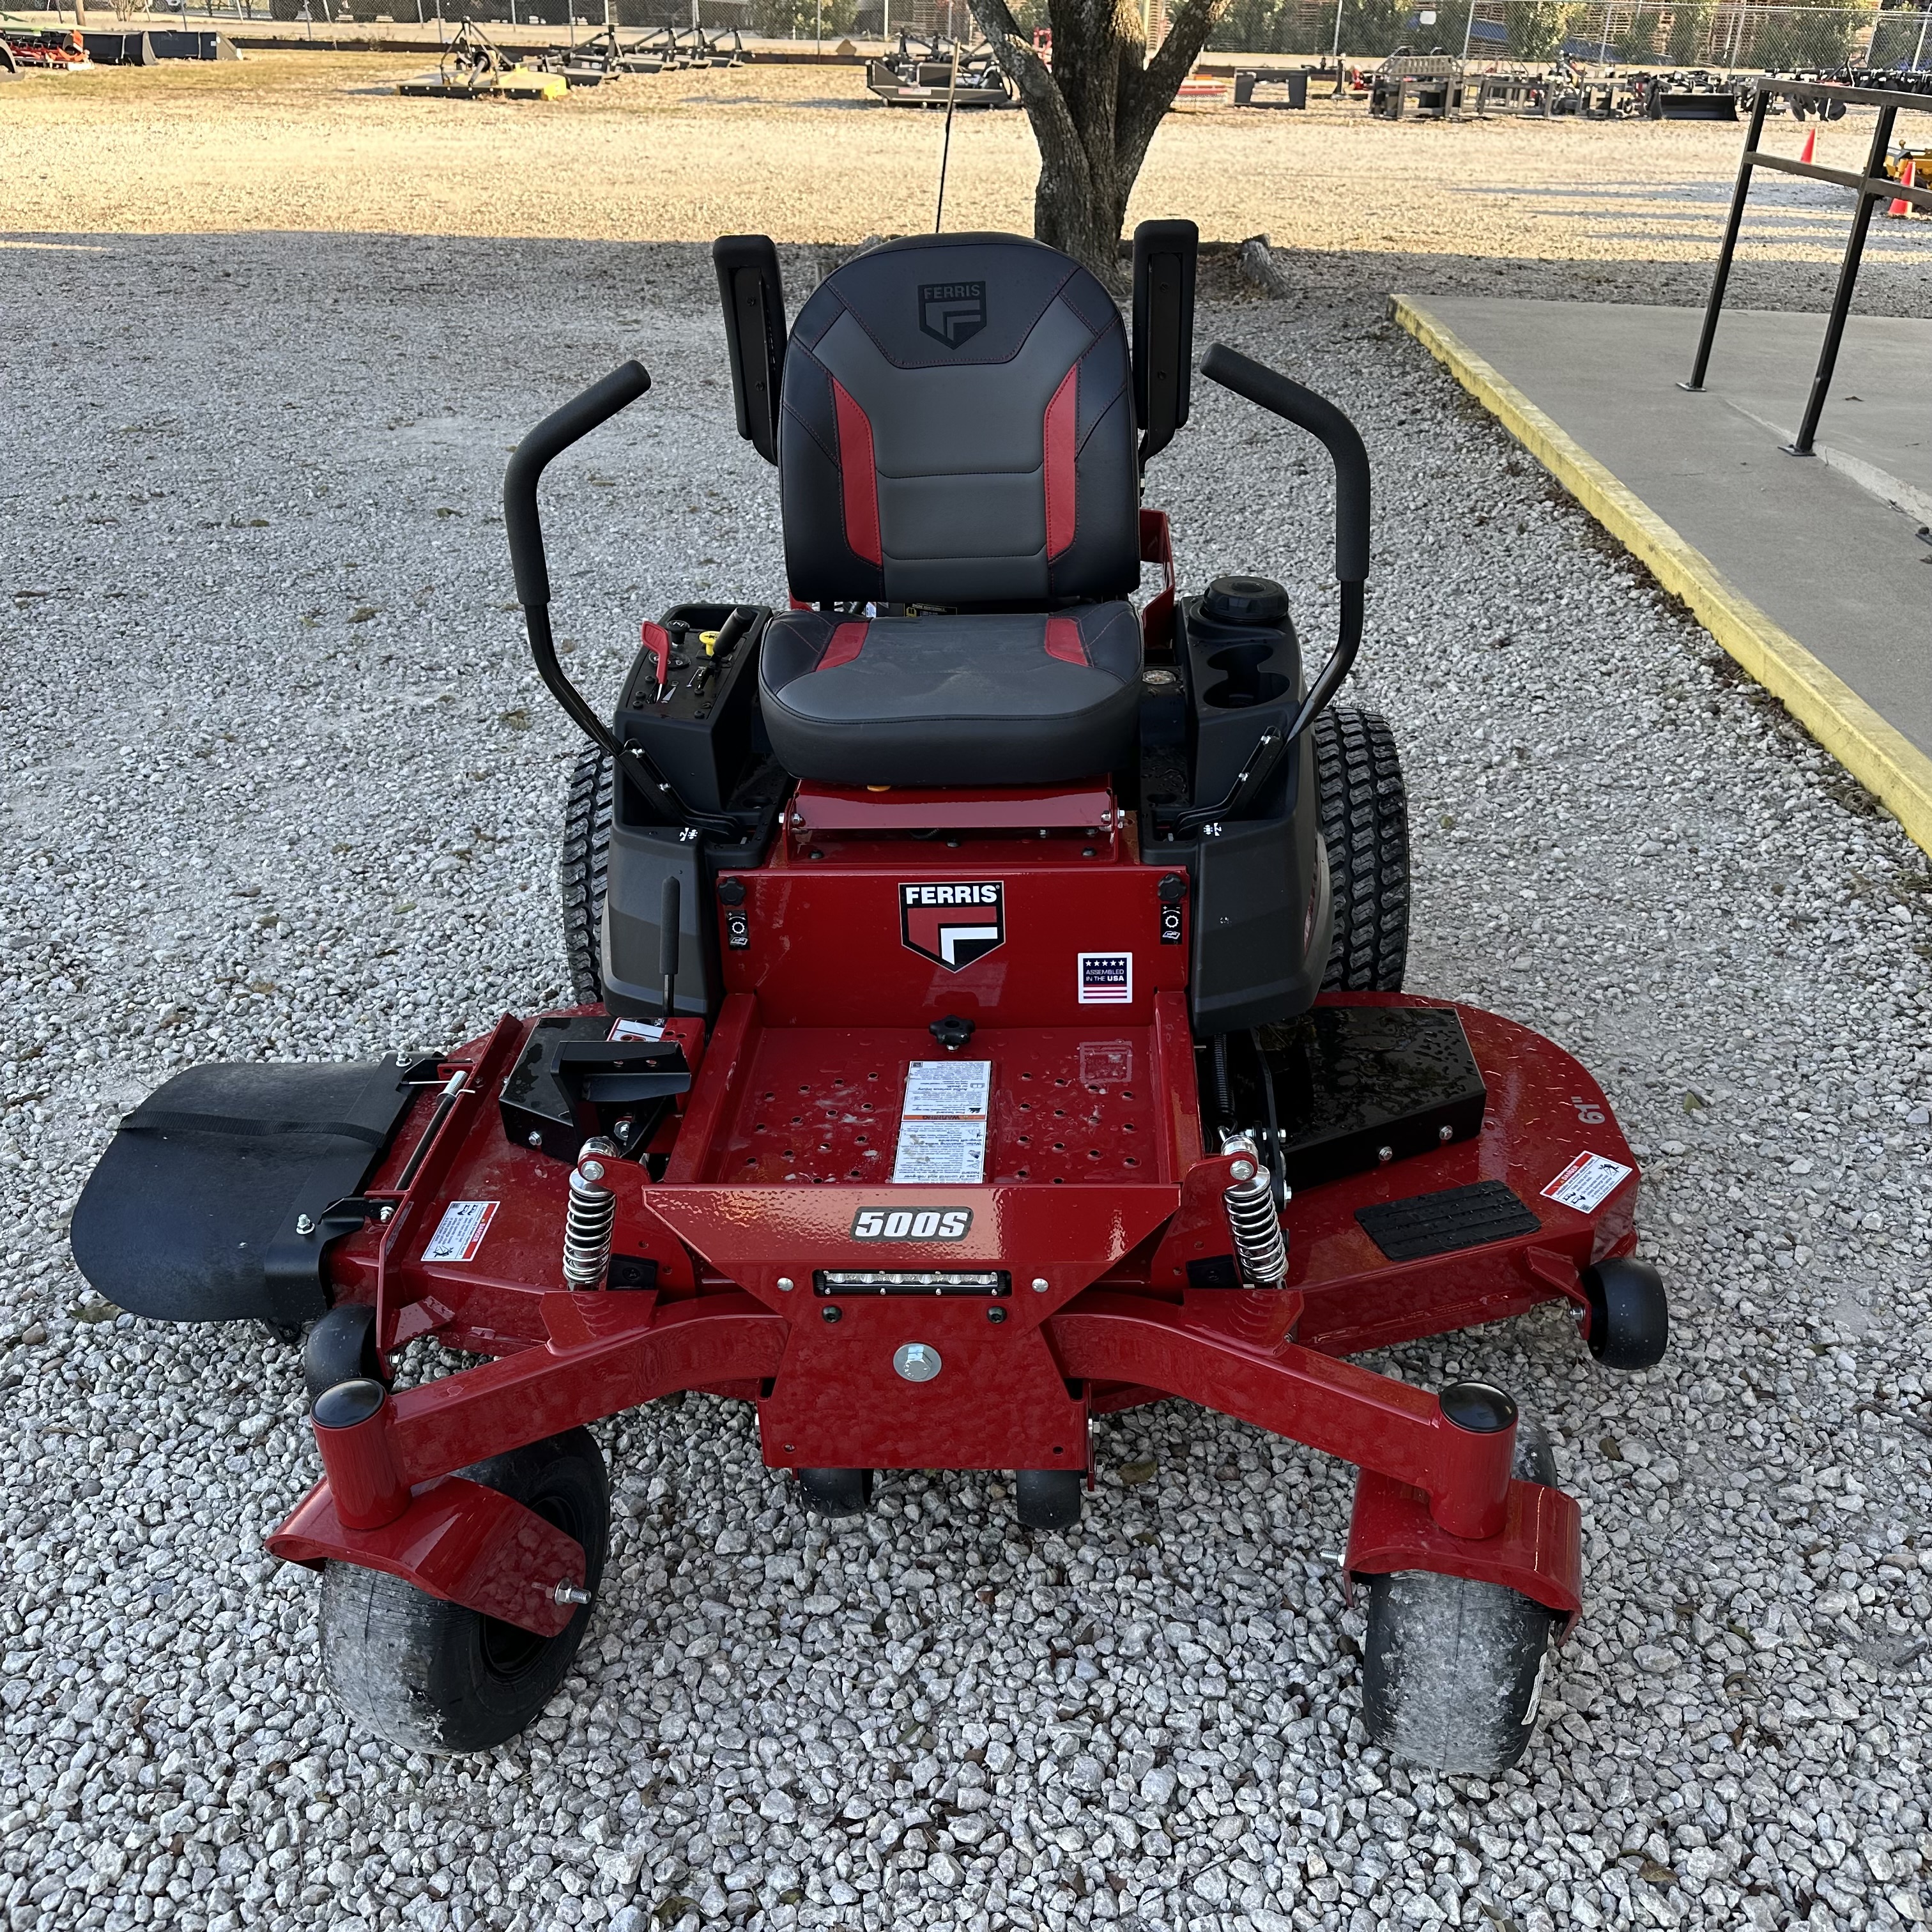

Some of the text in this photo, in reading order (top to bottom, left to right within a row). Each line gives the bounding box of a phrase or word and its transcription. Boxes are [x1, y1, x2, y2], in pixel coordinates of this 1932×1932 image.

[924, 284, 981, 300] FERRIS
[906, 885, 997, 904] FERRIS
[1560, 1165, 1580, 1180] DANGER
[471, 1223, 486, 1242] DANGER
[855, 1212, 968, 1237] 500S
